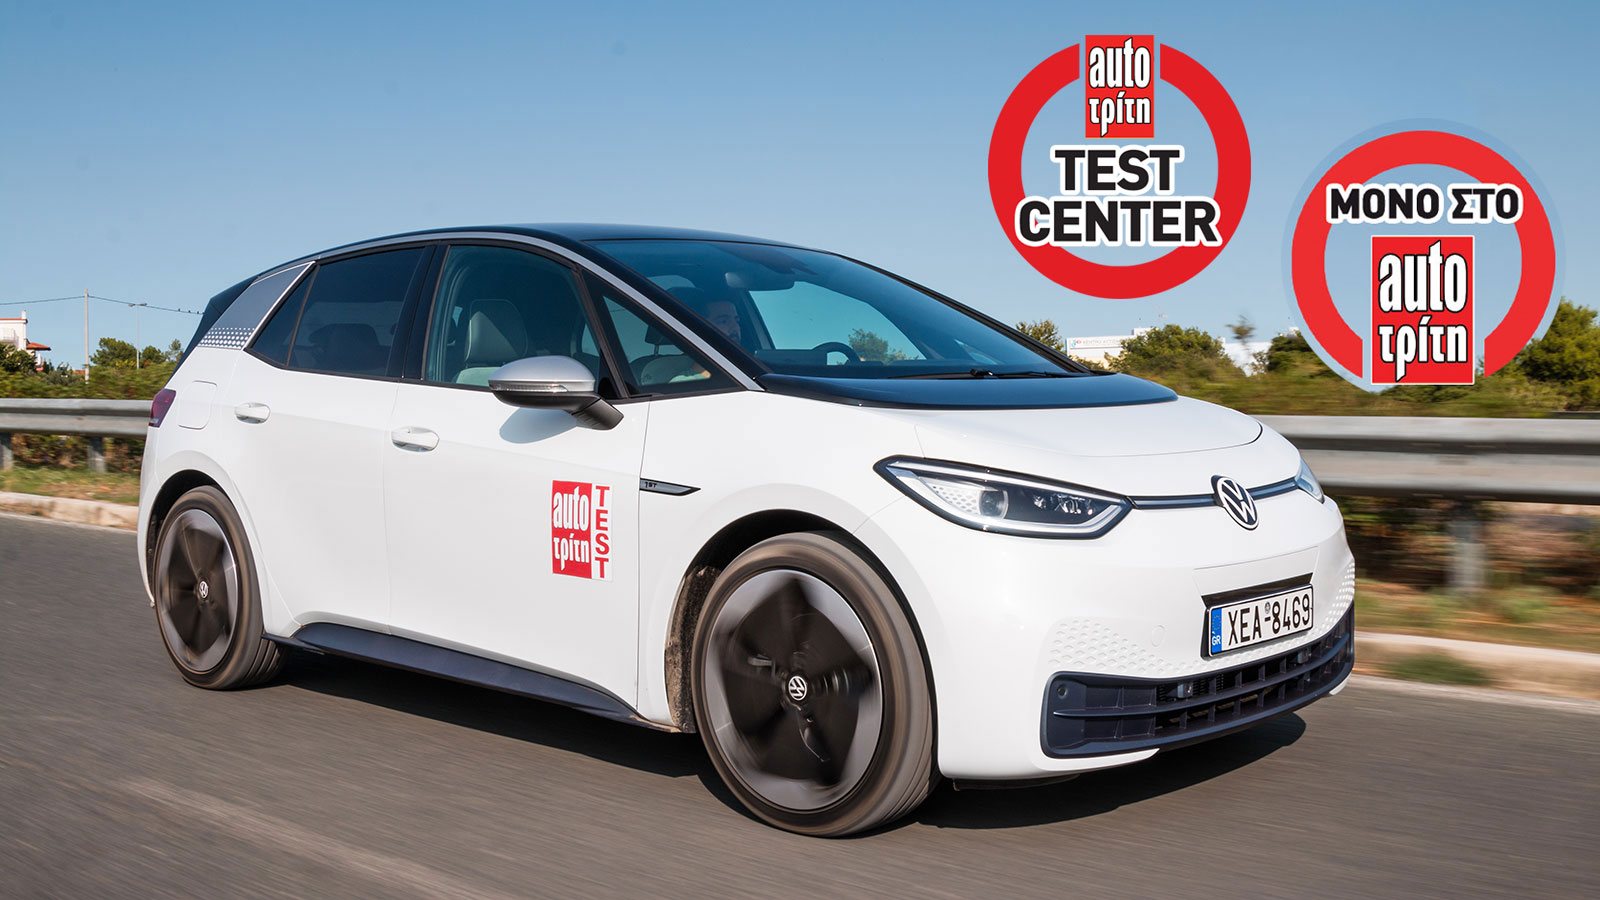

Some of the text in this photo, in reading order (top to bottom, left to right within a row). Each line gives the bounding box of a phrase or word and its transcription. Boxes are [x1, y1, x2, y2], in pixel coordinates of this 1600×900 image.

[552, 485, 590, 532] auto
[552, 532, 590, 571] τρίτη
[594, 485, 611, 579] TEST
[1211, 635, 1222, 646] GR
